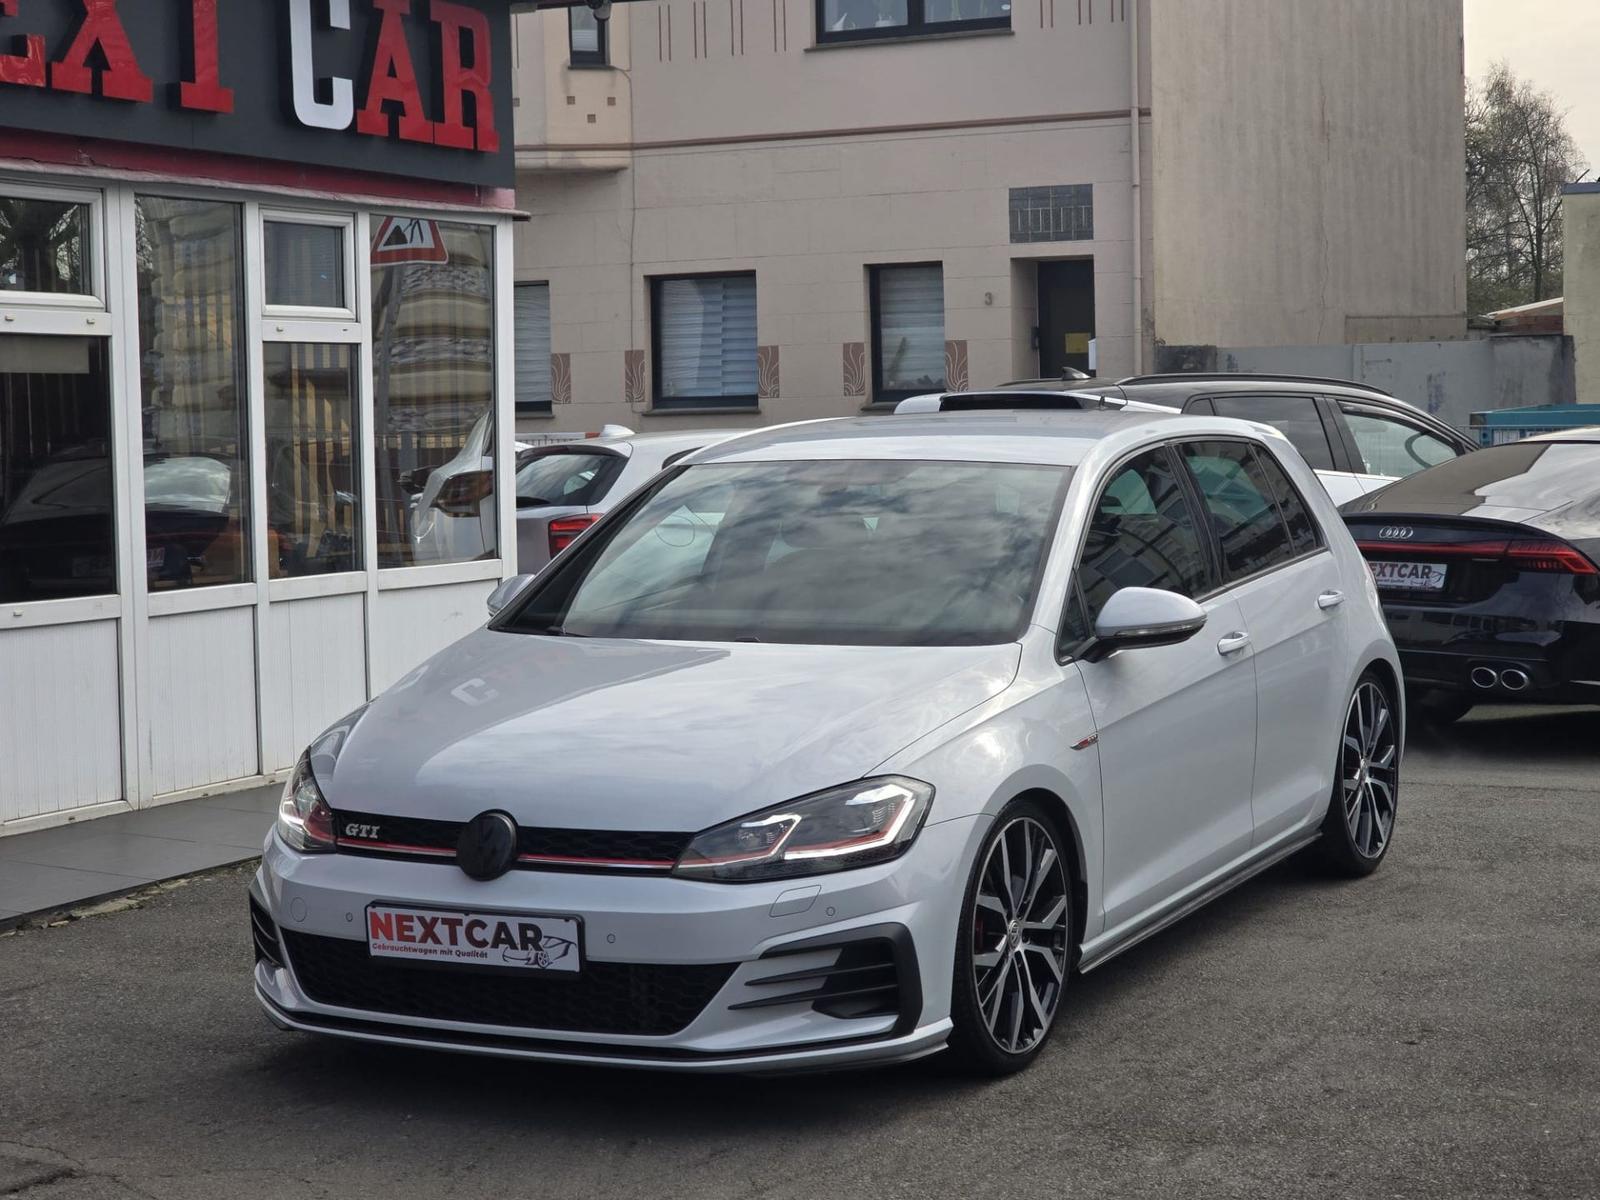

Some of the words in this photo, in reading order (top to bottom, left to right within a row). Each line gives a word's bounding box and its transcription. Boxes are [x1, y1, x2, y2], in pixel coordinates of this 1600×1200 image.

[290, 0, 499, 152] CAR
[984, 291, 993, 306] 3
[345, 823, 380, 839] GTI
[369, 911, 545, 951] NEXTCAR
[371, 943, 438, 955] Gebrauchtwagen
[439, 948, 453, 956] mit
[455, 949, 488, 959] Qualität
